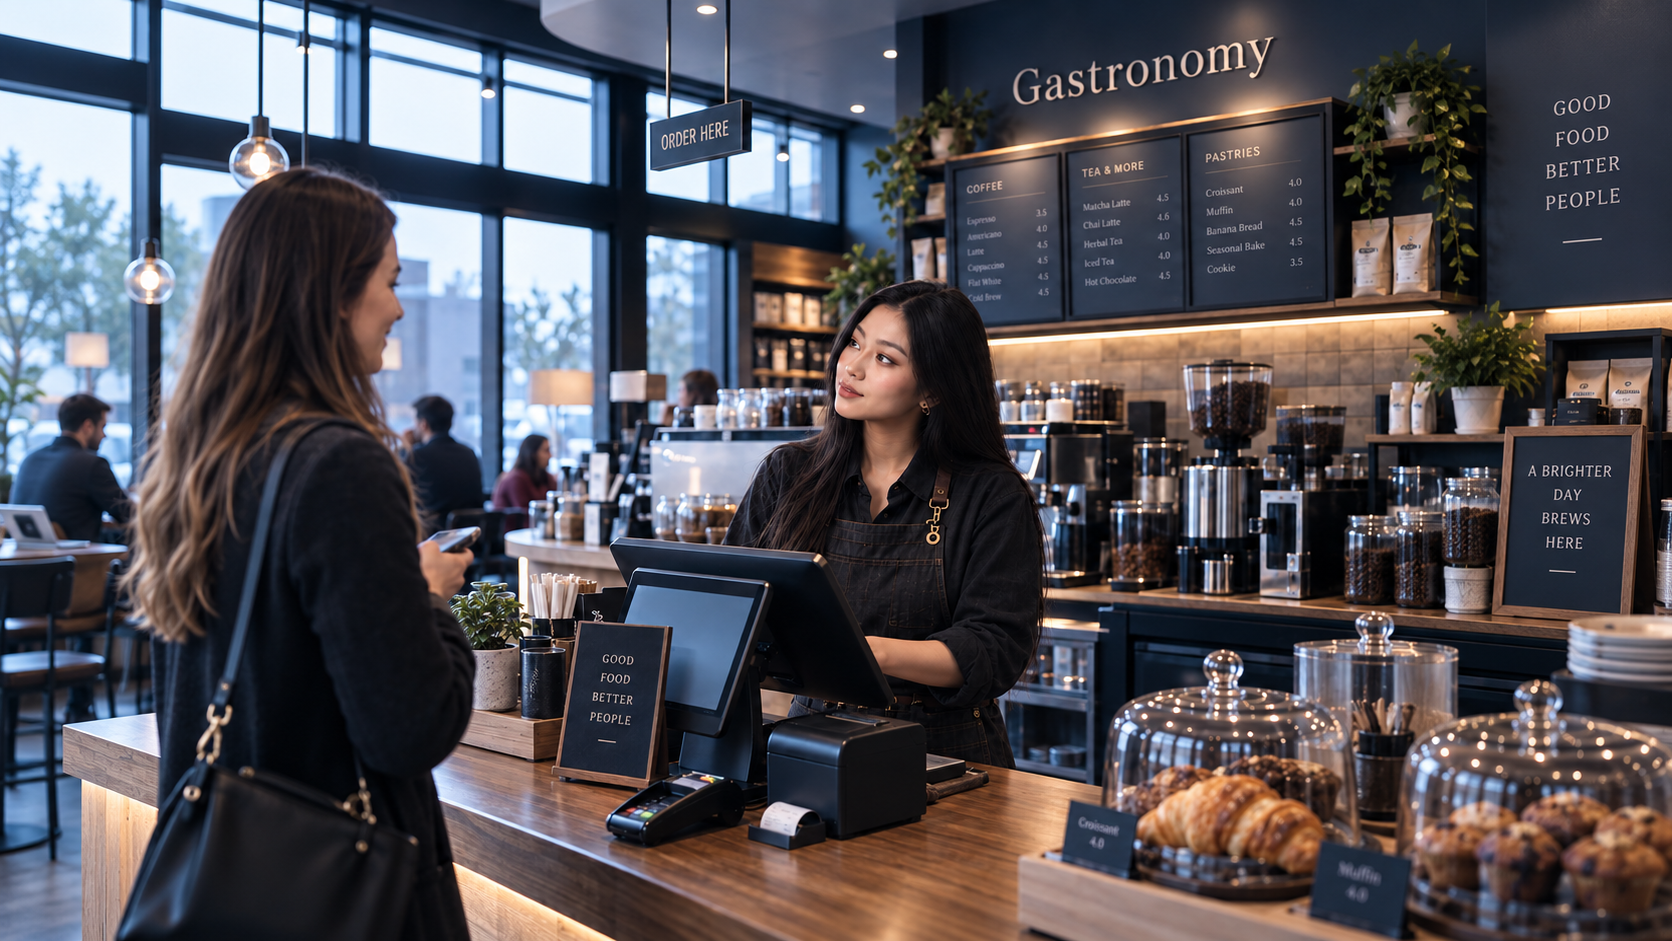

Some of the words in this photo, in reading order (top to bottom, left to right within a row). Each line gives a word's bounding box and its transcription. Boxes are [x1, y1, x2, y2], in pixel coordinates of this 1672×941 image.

[1012, 36, 1274, 106] Gastronomy
[1553, 93, 1611, 116] GOOD
[661, 128, 697, 151] ORDER
[700, 119, 729, 142] HERE
[1555, 125, 1610, 147] FOOD
[1205, 146, 1260, 163] PASTRIES
[1082, 167, 1101, 178] TEA
[1104, 165, 1111, 175] &
[1114, 160, 1144, 174] MORE
[1546, 155, 1620, 180] BETTER
[966, 180, 1003, 194] COFFEE
[1205, 185, 1244, 198] Croissant
[1288, 177, 1302, 187] 4.0
[1083, 201, 1110, 212] Matcha
[1112, 199, 1131, 208] Latte
[1156, 193, 1170, 202] 4.5
[1206, 205, 1234, 217] Muffin
[1288, 197, 1303, 207] 4.0
[1545, 187, 1621, 211] PEOPLE
[1035, 208, 1047, 217] 3.5
[1036, 224, 1048, 233] 4.0
[1083, 219, 1100, 230] Chai
[1102, 218, 1121, 228] Latte
[1206, 225, 1237, 236] Banana
[1239, 221, 1263, 232] Bread
[1289, 217, 1303, 227] 4.5
[1037, 240, 1048, 249] 4.5
[1084, 238, 1108, 249] Herbal
[1110, 237, 1123, 246] Tea
[1157, 232, 1170, 241] 4.0
[1206, 243, 1243, 255] Seasonal
[1245, 241, 1265, 251] Bake
[1289, 237, 1303, 246] 4.5
[1037, 256, 1048, 264] 4.5
[1084, 258, 1100, 268] Iced
[1101, 257, 1115, 266] Tea
[1158, 251, 1171, 260] 4.0
[1207, 263, 1236, 274] Cookie
[1290, 257, 1303, 267] 3.5
[1038, 272, 1049, 281] 4.5
[1085, 278, 1098, 287] Hot
[1099, 275, 1137, 285] Chocolate
[1158, 271, 1171, 280] 4.5
[1038, 288, 1050, 296] 4.5
[1527, 465, 1537, 477] A
[1542, 465, 1612, 478] BRIGHTER
[1553, 488, 1582, 501] DAY
[1541, 512, 1591, 526] BREWS
[1546, 536, 1583, 550] HERE
[602, 653, 634, 666] GOOD
[600, 672, 631, 685] FOOD
[592, 691, 633, 706] BETTER
[589, 711, 632, 726] PEOPLE
[1078, 816, 1120, 837] Croissant
